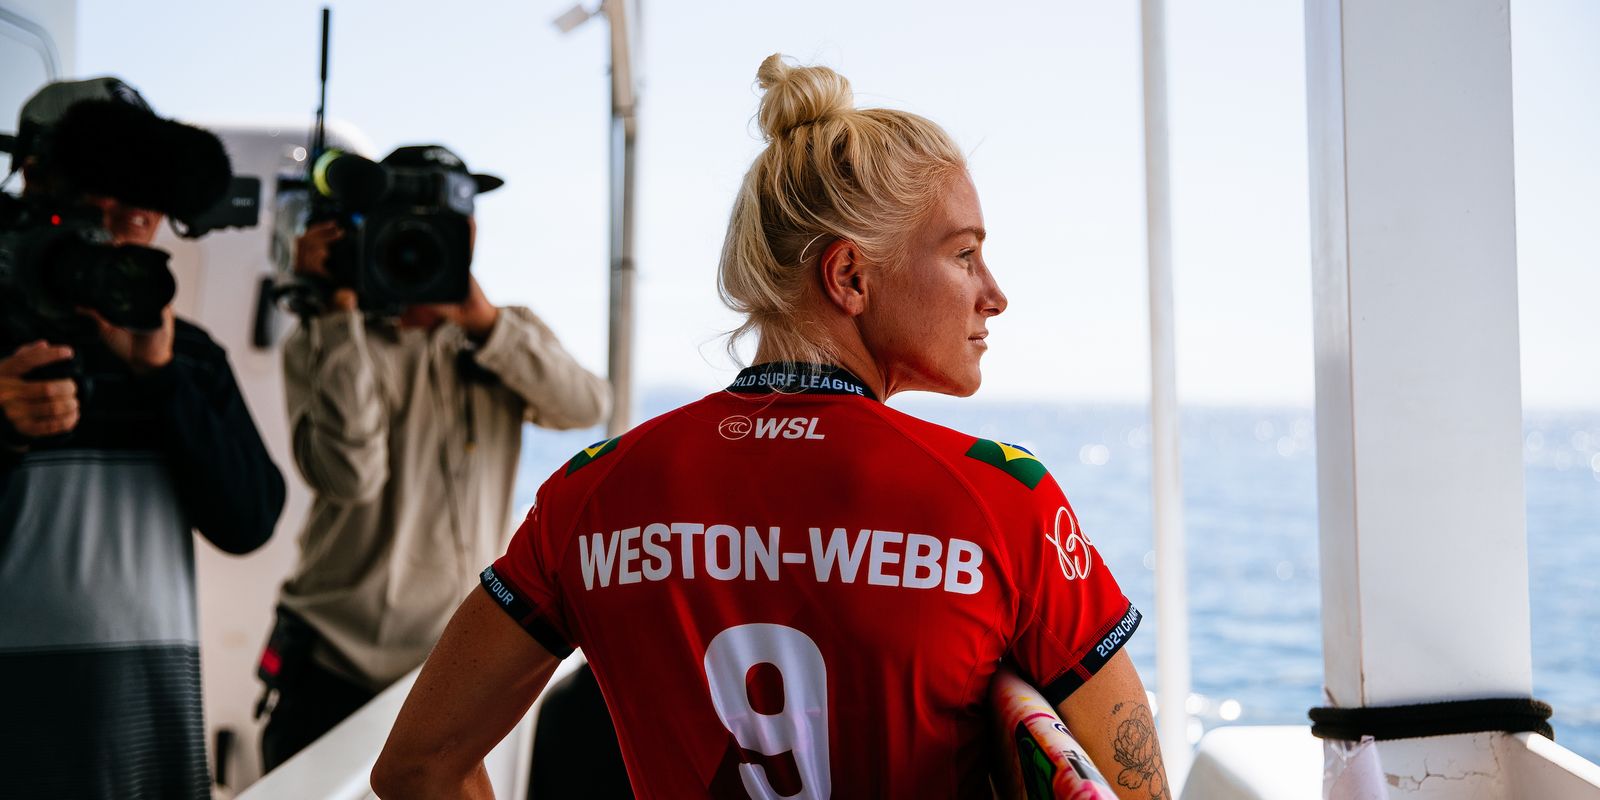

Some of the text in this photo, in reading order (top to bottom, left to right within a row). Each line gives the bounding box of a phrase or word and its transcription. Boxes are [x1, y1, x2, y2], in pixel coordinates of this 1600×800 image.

[758, 372, 796, 387] SURF
[800, 374, 864, 396] LEAGUE
[754, 417, 826, 440] WSL
[579, 522, 984, 595] WESTON-WEBB
[489, 577, 514, 606] TOUR
[1096, 626, 1126, 657] 2024
[704, 623, 832, 800] 9
